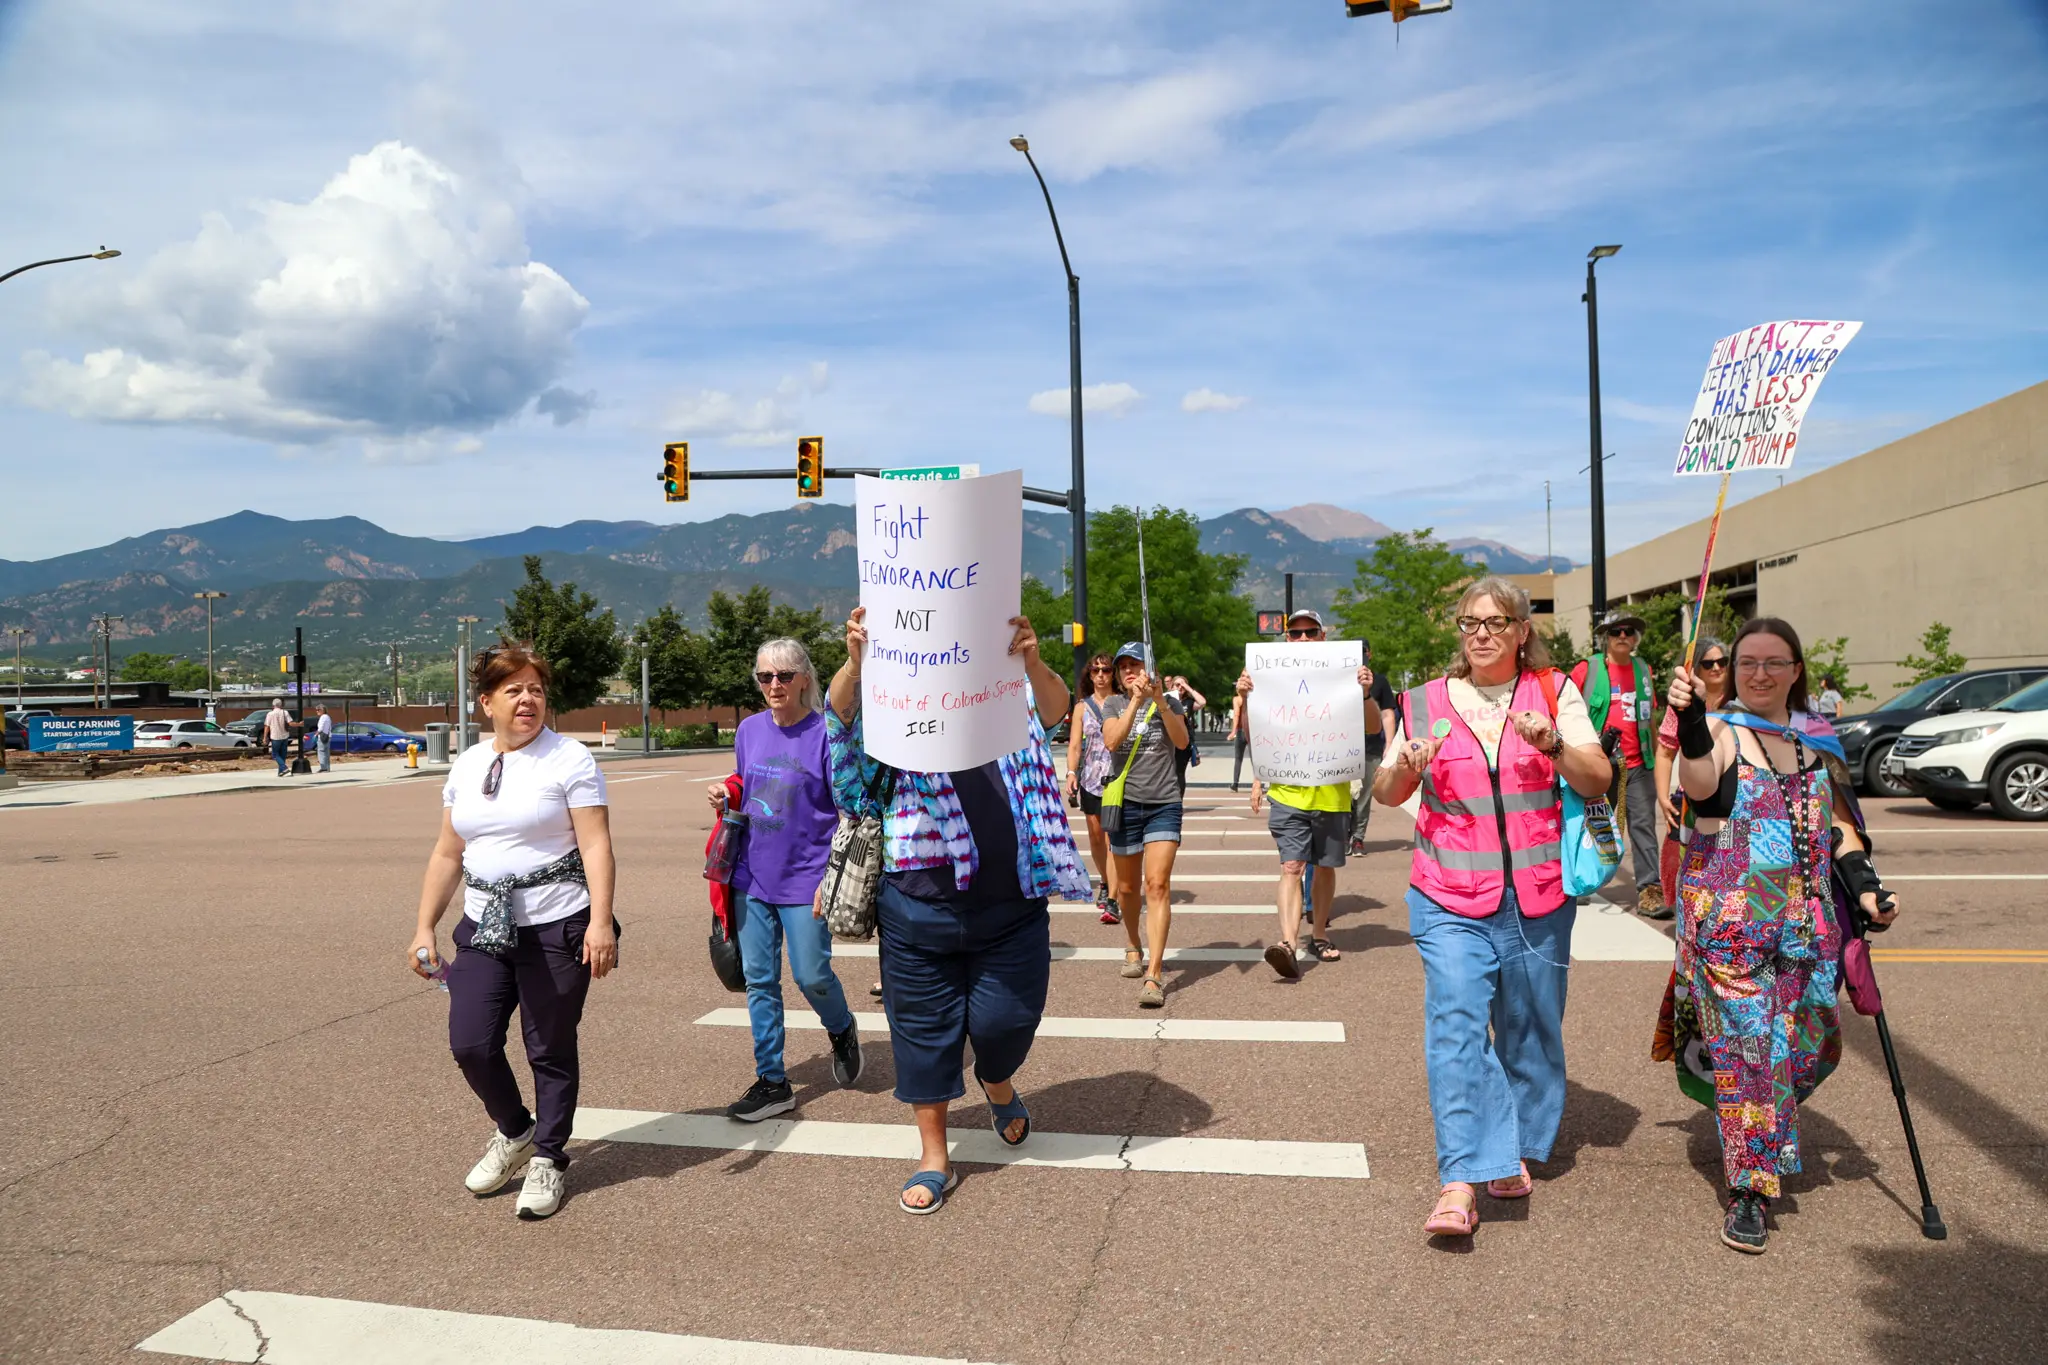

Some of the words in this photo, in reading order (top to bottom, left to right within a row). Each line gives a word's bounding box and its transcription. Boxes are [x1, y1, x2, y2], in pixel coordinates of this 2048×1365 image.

[1708, 332, 1742, 366] FUN
[1702, 352, 1768, 394] JEFFREY
[1766, 348, 1838, 377] DAHMER
[1711, 382, 1749, 416] HAS
[1754, 373, 1814, 408] LESS
[1684, 406, 1780, 444] CONVICTIONS
[1781, 404, 1800, 430] THAN
[1676, 438, 1741, 474] DONALD
[1740, 431, 1797, 468] TRUMP
[884, 471, 942, 480] Cascade
[874, 504, 929, 558] Fight
[862, 560, 979, 591] IGNORANCE
[895, 609, 936, 632] NOT
[872, 639, 970, 677] Immigrants
[1254, 654, 1330, 670] DETENTION
[1343, 656, 1358, 668] IS
[872, 684, 888, 705] Get
[892, 694, 911, 711] out
[916, 694, 931, 712] of
[941, 686, 991, 710] Colorado
[993, 678, 1024, 701] Springs
[1298, 679, 1310, 694] A
[42, 721, 76, 729] PUBLIC
[78, 720, 120, 728] PARKING
[1268, 703, 1332, 724] MAGA
[906, 720, 944, 738] ICE!
[1273, 751, 1300, 766] SAY
[1308, 750, 1338, 765] HELL
[1346, 745, 1360, 757] NO
[1258, 765, 1310, 780] COLORADO
